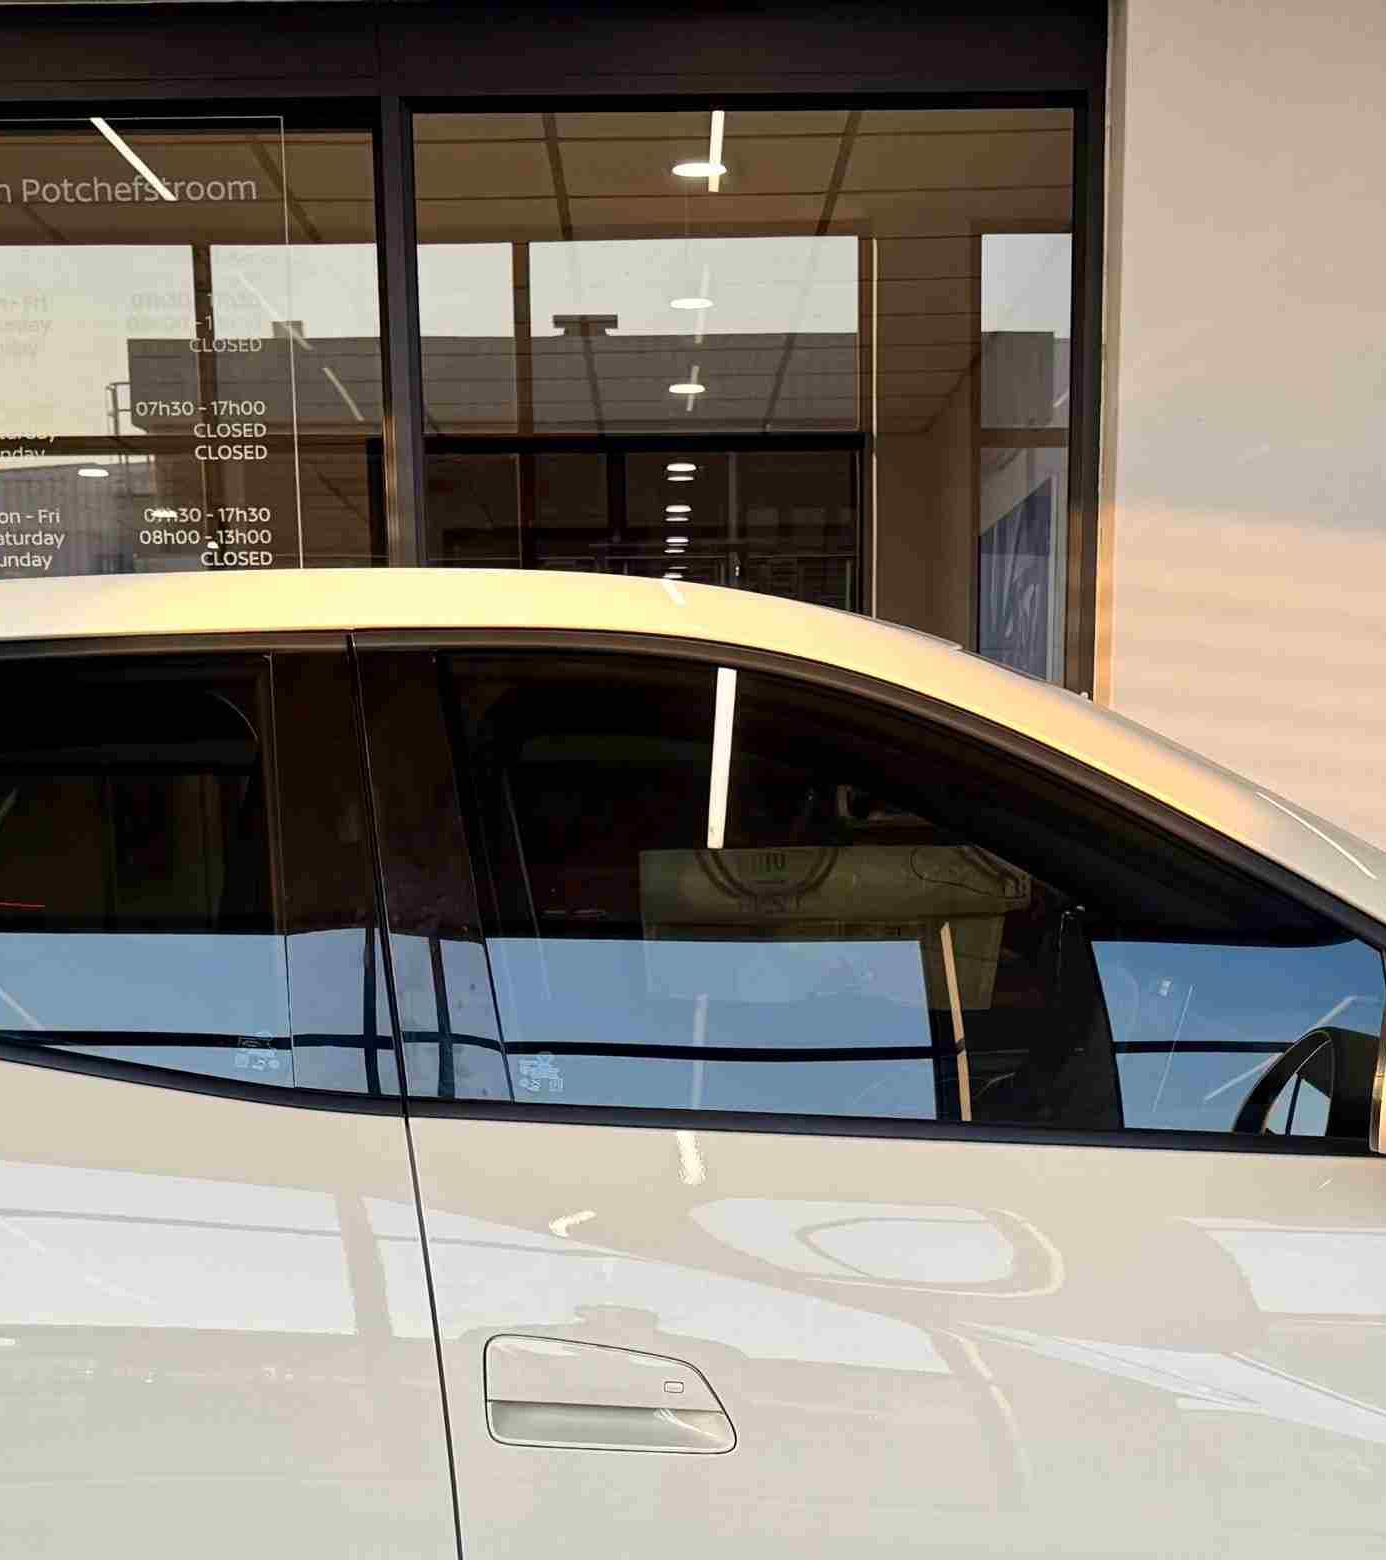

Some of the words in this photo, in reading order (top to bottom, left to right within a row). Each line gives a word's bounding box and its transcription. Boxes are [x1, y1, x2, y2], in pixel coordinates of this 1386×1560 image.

[21, 175, 258, 203] Potchefstroom
[189, 338, 262, 352] CLOSED
[135, 400, 195, 416] 07h30
[211, 400, 266, 416] 17h00
[193, 423, 267, 438] CLOSED
[194, 444, 268, 460] CLOSED
[37, 508, 61, 524] Fri
[144, 507, 202, 522] 030
[217, 507, 271, 522] 17h30
[139, 529, 201, 545] 08h00
[216, 529, 272, 545] 13h00
[200, 551, 273, 566] CLOSED
